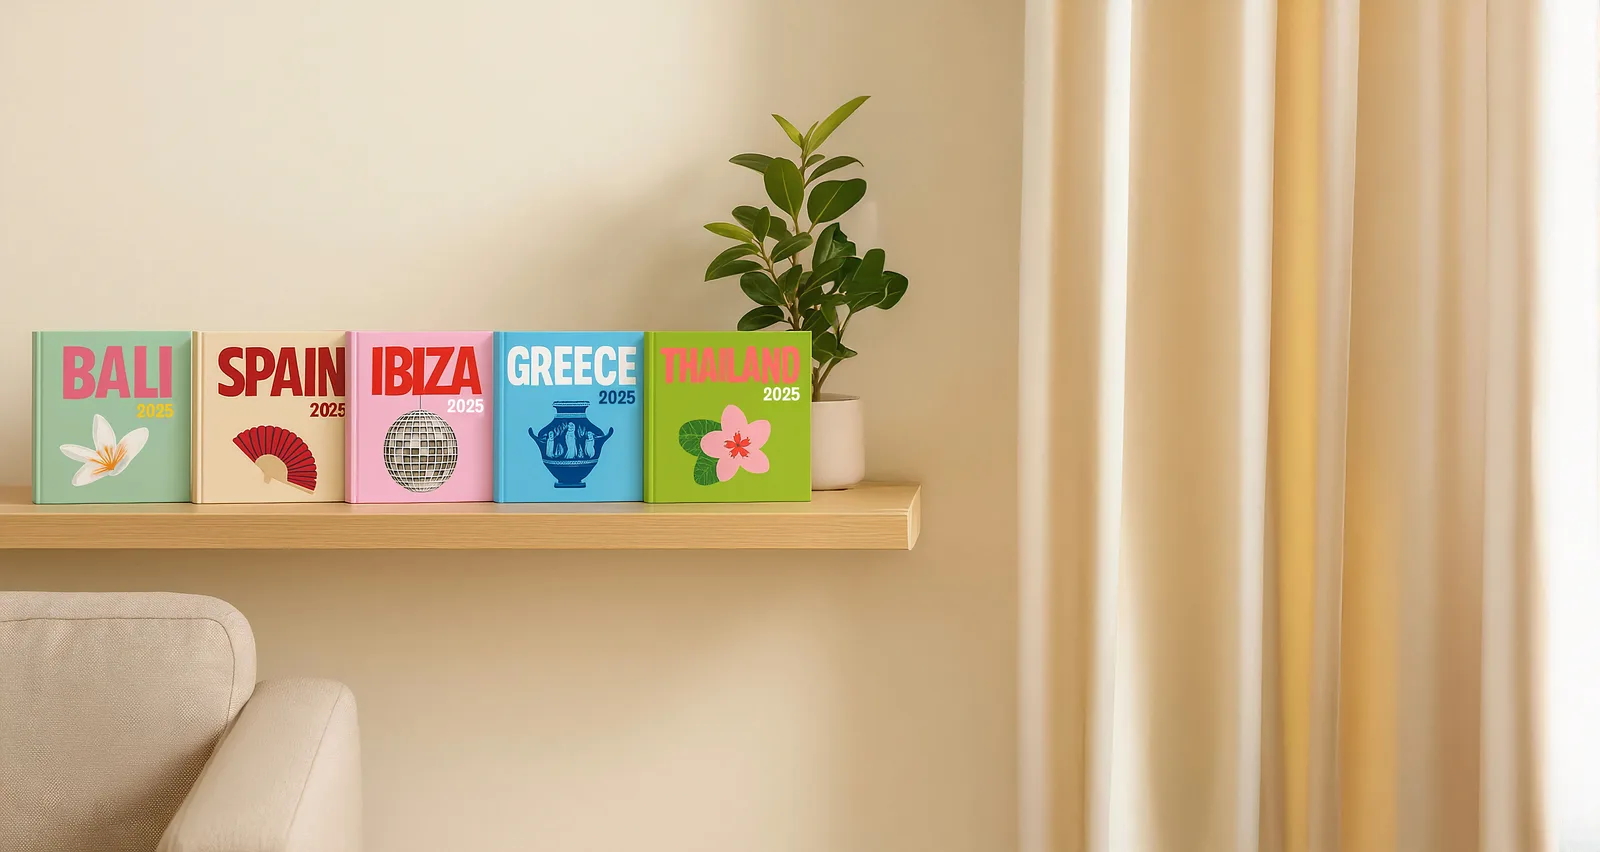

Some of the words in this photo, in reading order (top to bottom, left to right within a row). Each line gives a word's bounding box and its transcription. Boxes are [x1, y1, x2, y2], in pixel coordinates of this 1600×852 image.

[62, 345, 173, 400] BALI
[217, 346, 346, 397] SPAIN
[371, 346, 482, 396] IBIZA
[507, 345, 637, 386] GREECE
[660, 345, 800, 384] THAILAND
[447, 398, 484, 414] 2025
[598, 389, 636, 405] 2025
[763, 386, 801, 402] 2025
[136, 403, 174, 419] 2025
[309, 402, 346, 418] 2025
